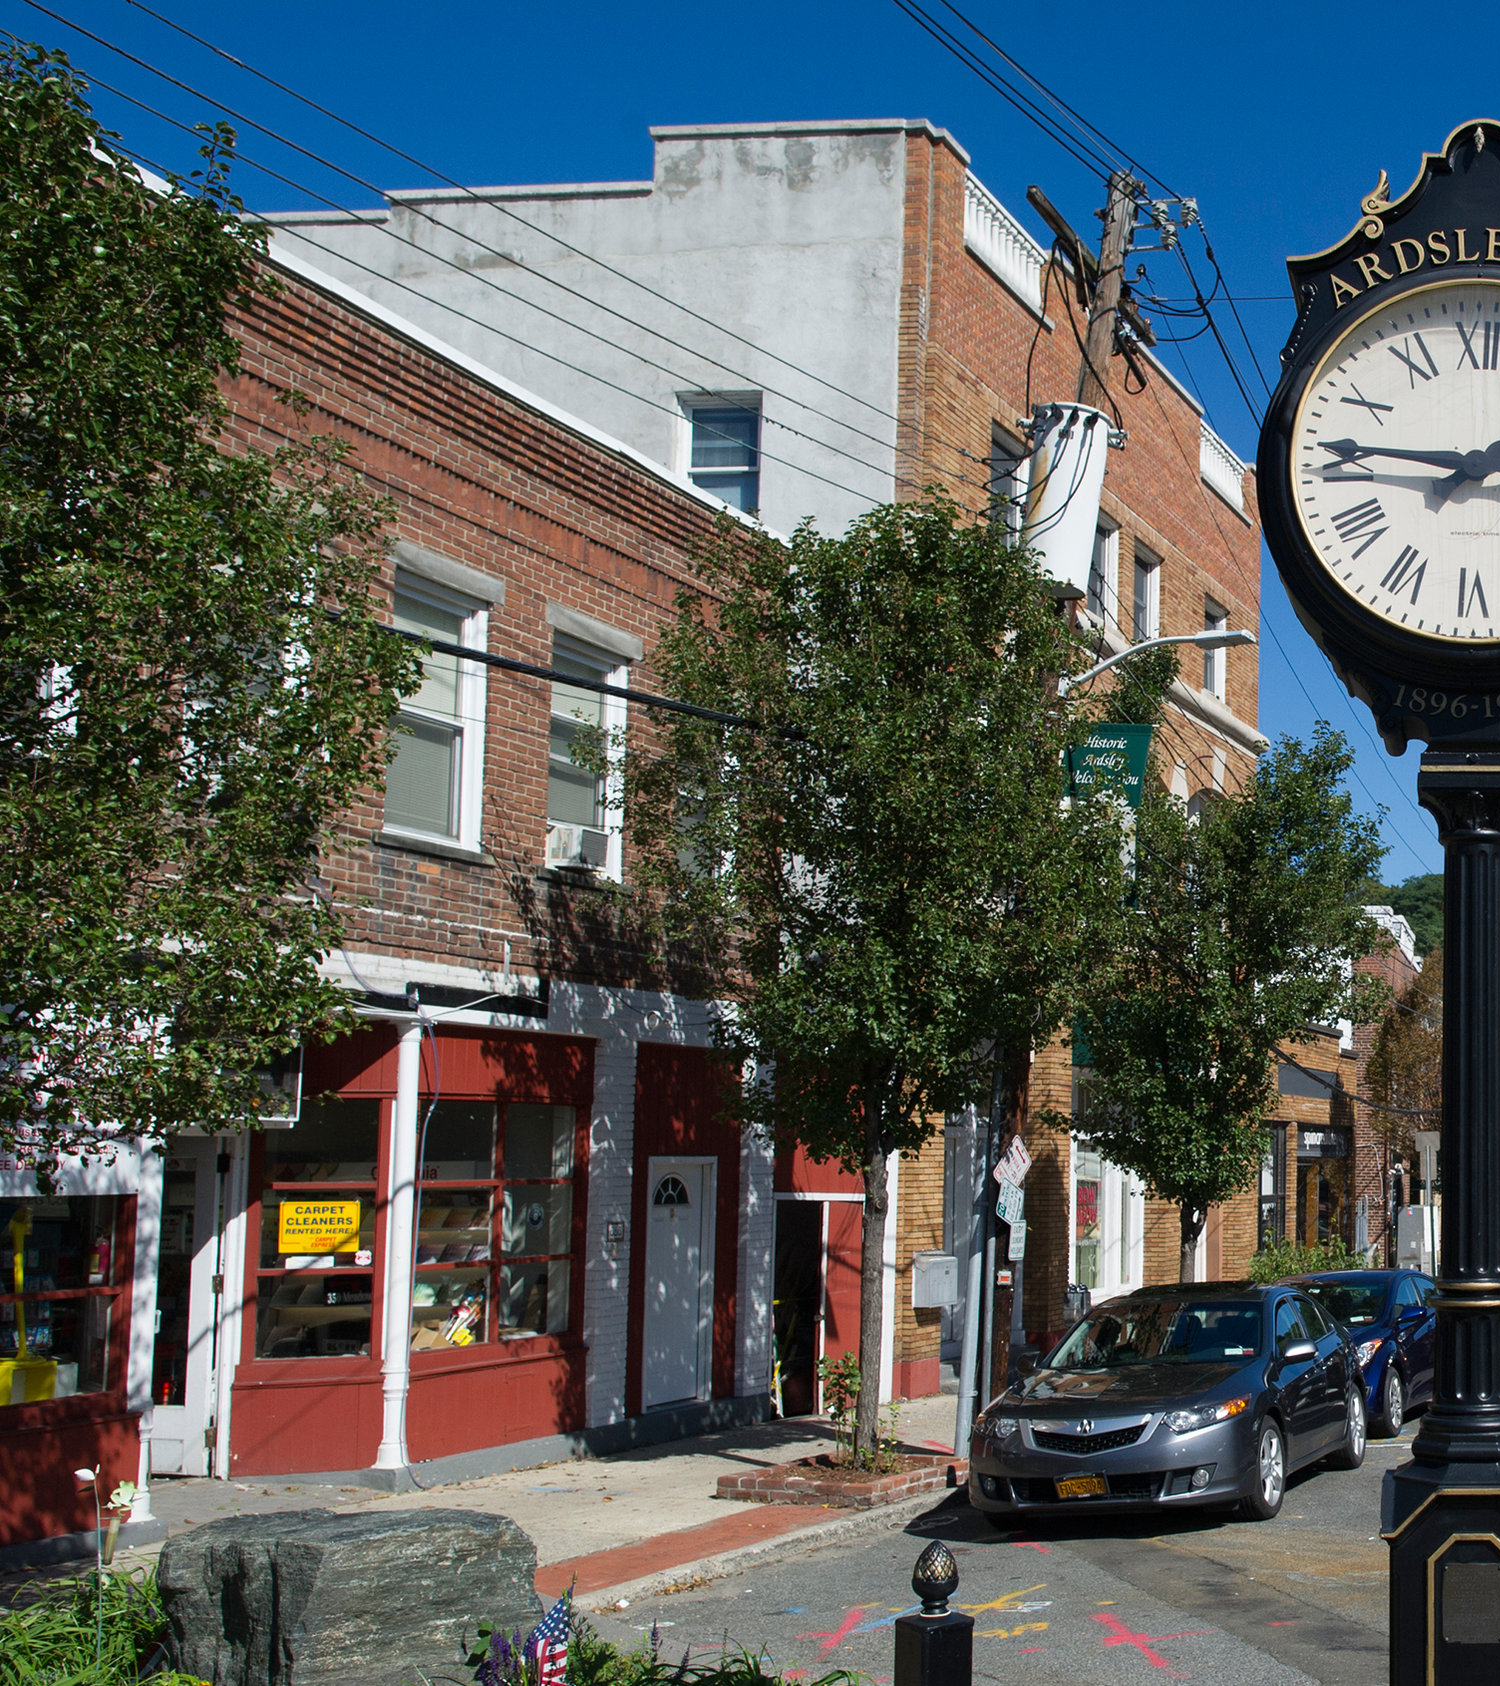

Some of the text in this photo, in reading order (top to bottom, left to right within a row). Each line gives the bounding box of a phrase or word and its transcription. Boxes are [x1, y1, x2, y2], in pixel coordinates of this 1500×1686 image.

[1083, 735, 1128, 749] Historic
[295, 1206, 345, 1214] CARPET
[286, 1217, 353, 1226] CLEANERS
[285, 1227, 322, 1235] RENTED
